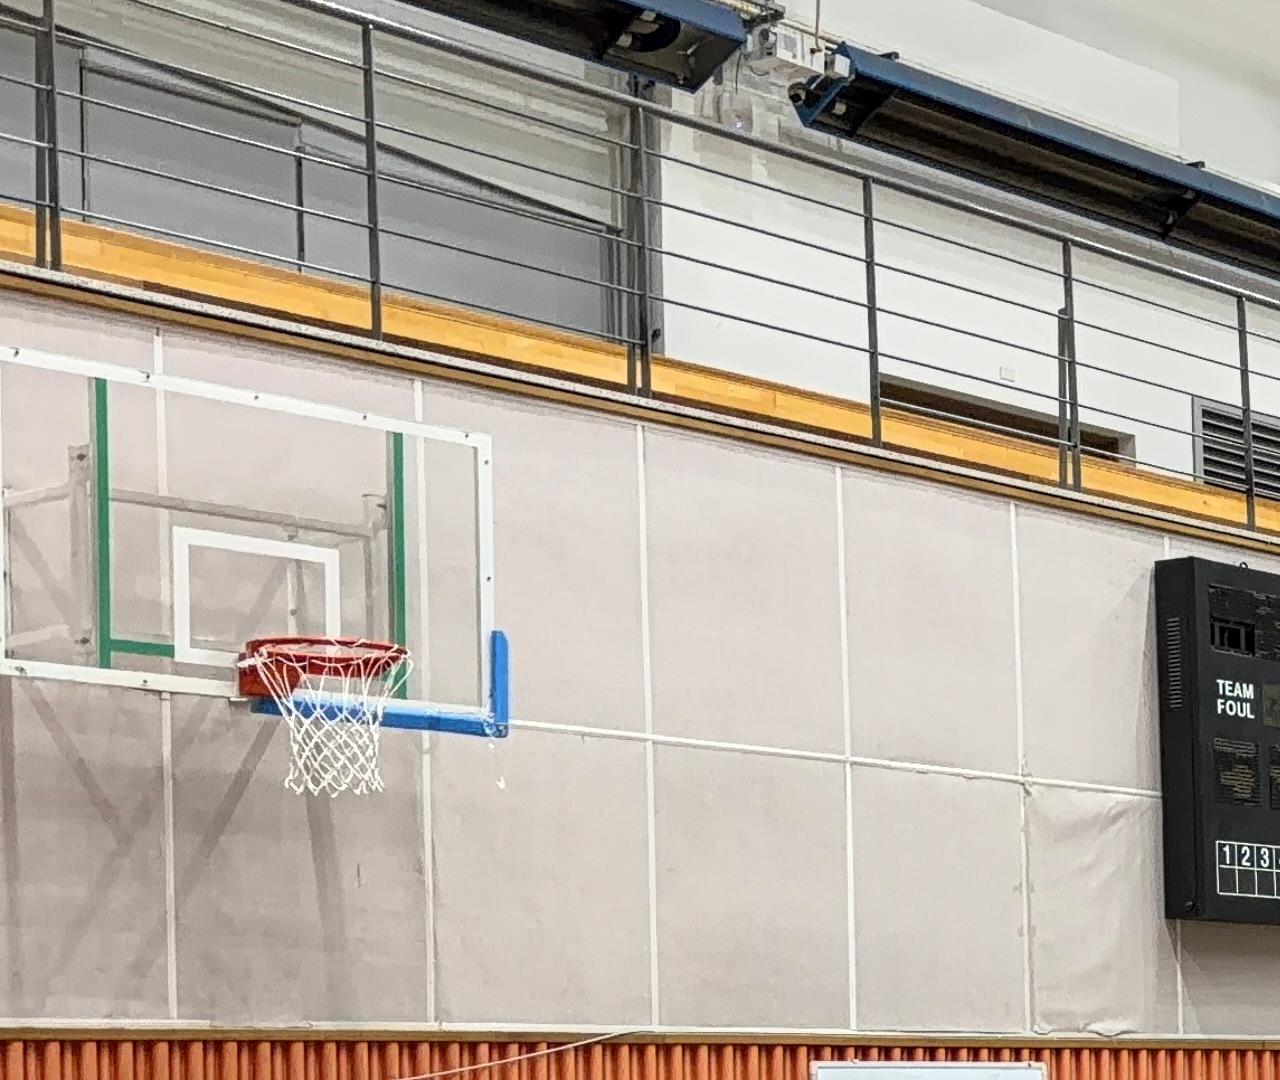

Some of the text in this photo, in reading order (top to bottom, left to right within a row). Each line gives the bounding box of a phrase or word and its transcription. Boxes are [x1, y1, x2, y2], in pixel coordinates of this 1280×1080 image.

[1216, 679, 1254, 700] TEAM
[1217, 698, 1256, 719] FOUL
[1222, 844, 1230, 865] 1
[1241, 846, 1251, 867] 2
[1260, 847, 1270, 868] 3
